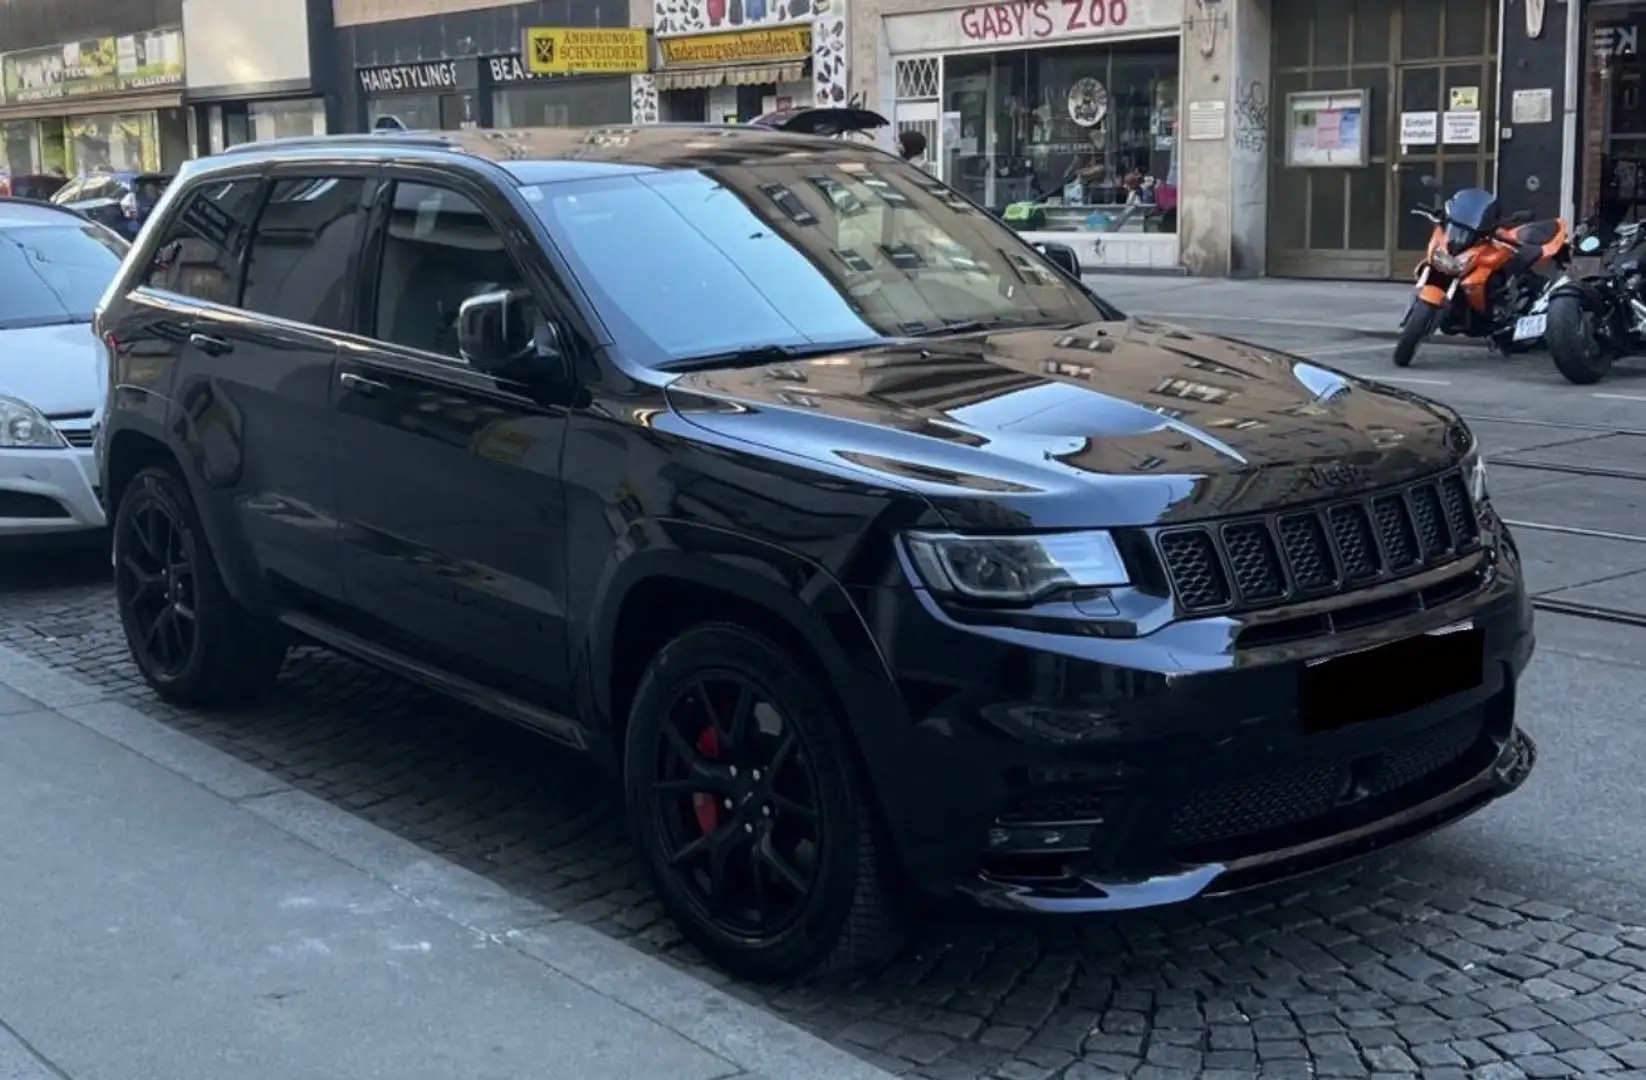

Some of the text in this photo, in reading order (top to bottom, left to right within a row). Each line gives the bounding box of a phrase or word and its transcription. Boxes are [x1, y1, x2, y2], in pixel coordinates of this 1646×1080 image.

[960, 0, 1128, 40] GABY'S ZOO
[559, 45, 644, 60] SCHNEIDEREI
